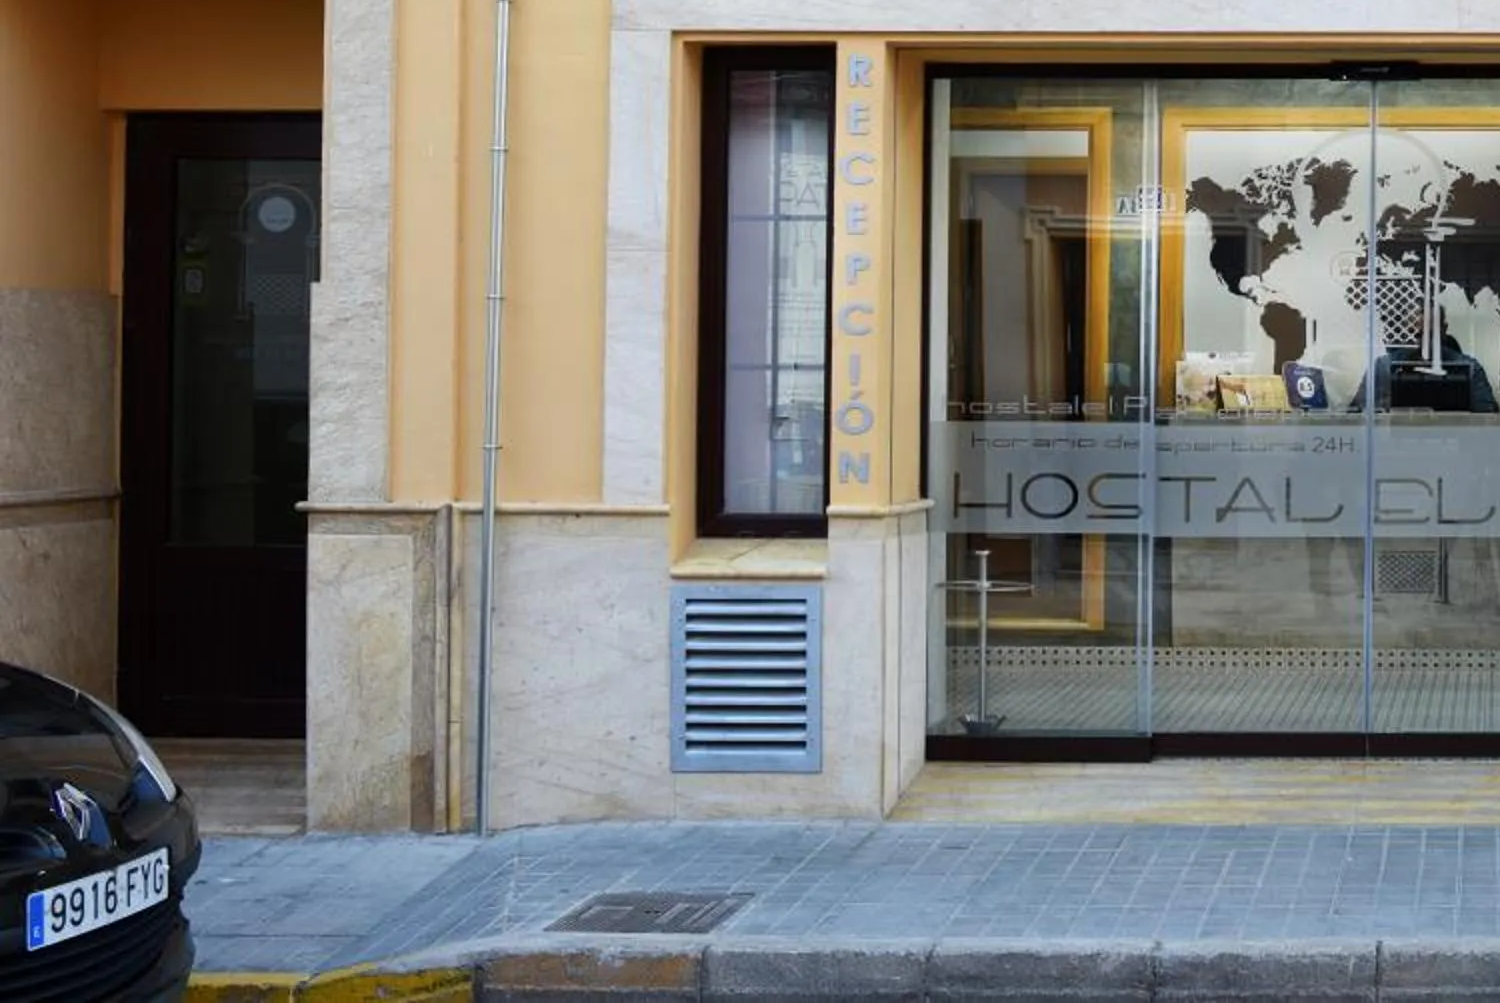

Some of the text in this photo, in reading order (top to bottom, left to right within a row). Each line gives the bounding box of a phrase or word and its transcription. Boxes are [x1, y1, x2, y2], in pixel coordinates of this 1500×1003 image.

[838, 53, 876, 484] RECEPCIÓN
[952, 471, 1345, 524] HOSTAL
[1373, 477, 1496, 525] EL
[50, 858, 165, 934] 9916 FYG
